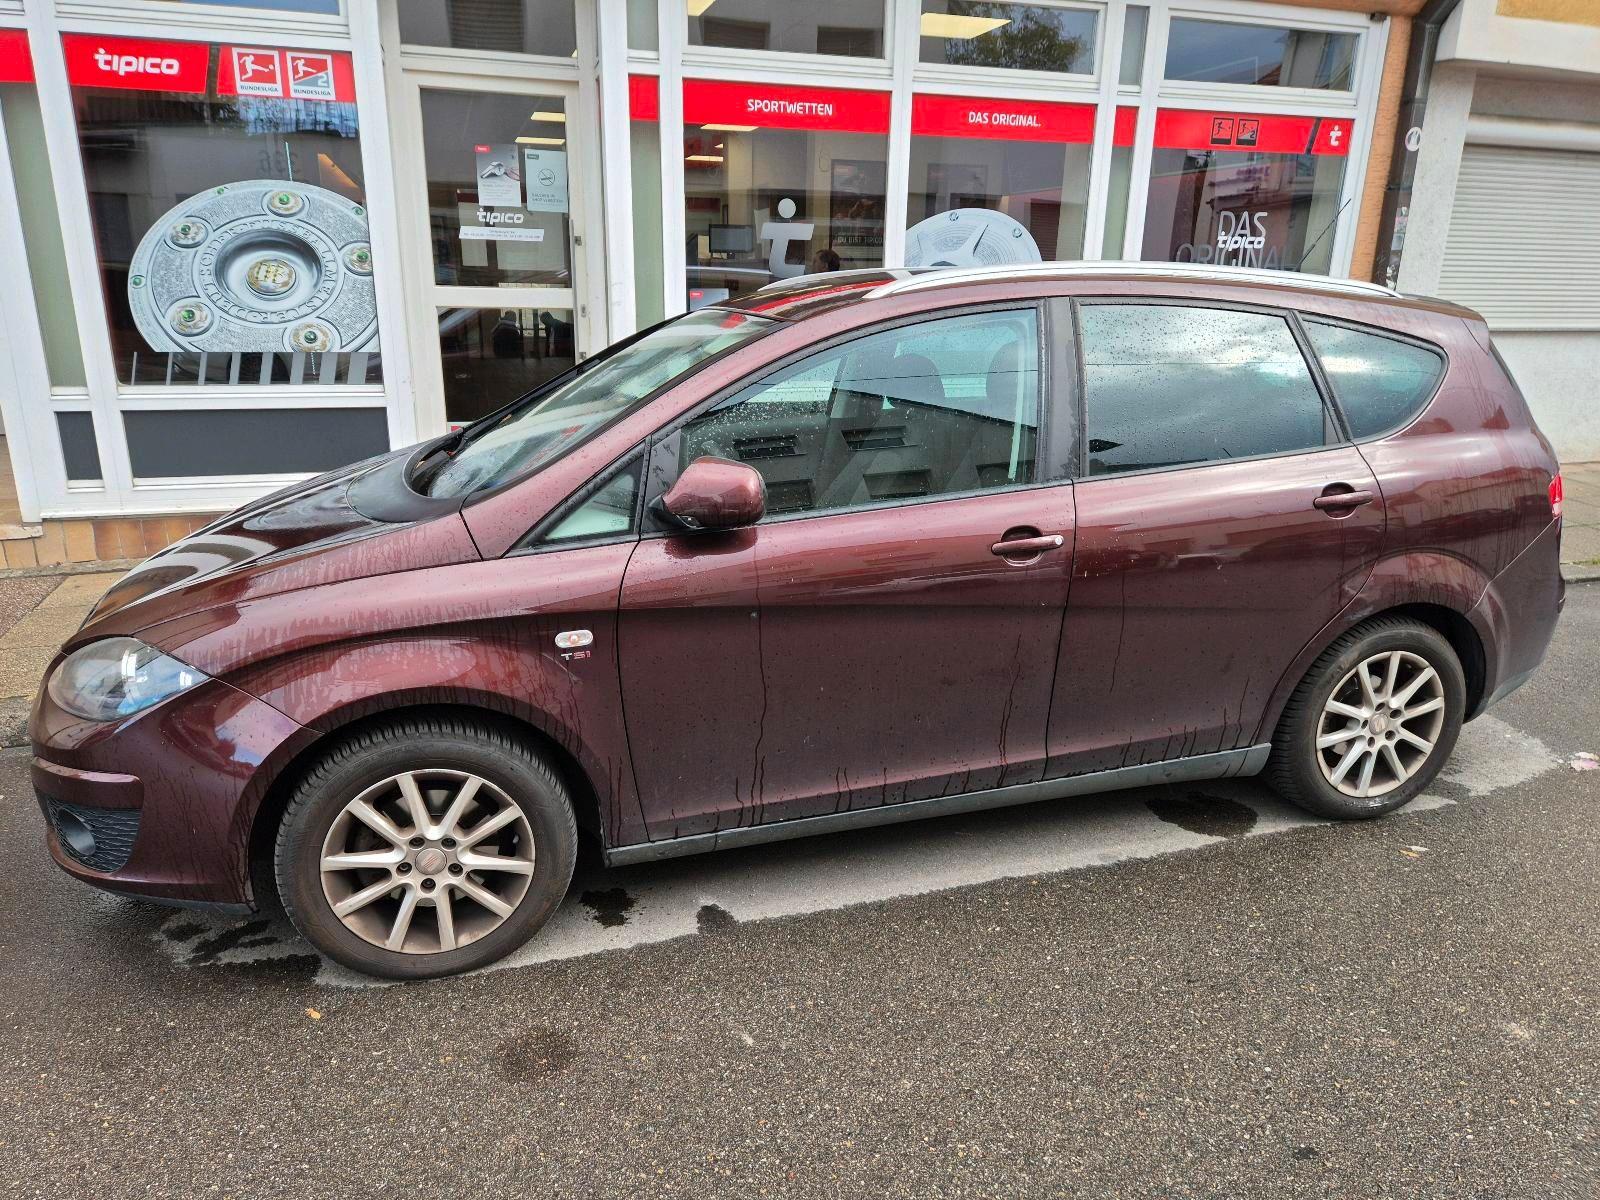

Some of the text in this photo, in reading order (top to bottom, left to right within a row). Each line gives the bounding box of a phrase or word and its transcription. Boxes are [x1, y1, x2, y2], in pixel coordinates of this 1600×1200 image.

[94, 48, 180, 76] tipico
[317, 73, 328, 87] 2
[747, 98, 833, 117] SPORTWETTEN
[968, 111, 1041, 127] DAS ORIGINAL.
[477, 207, 524, 225] tipico
[1217, 210, 1268, 240] DAS
[1217, 230, 1266, 251] tipico
